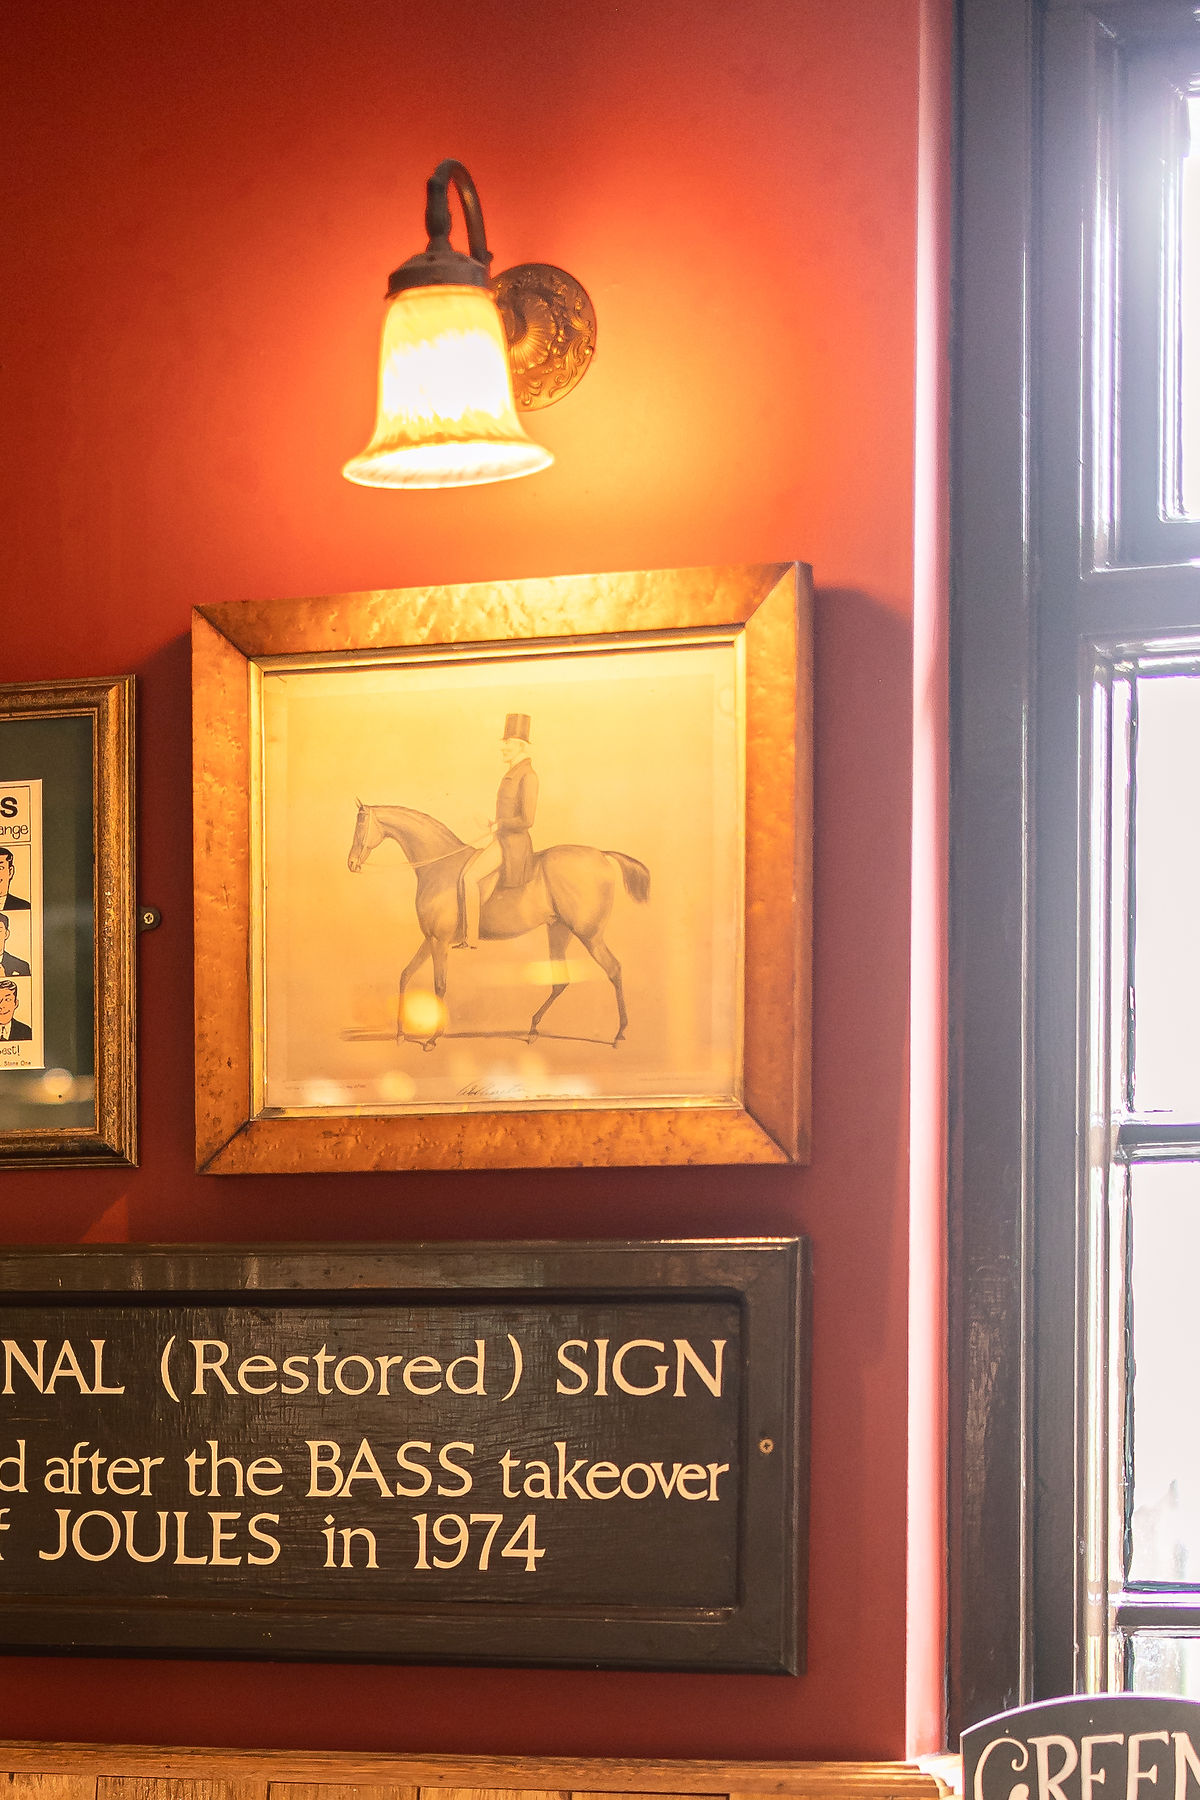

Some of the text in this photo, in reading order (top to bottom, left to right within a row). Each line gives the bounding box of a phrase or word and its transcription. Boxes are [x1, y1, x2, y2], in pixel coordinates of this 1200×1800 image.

[160, 1333, 524, 1403] (Restored)
[556, 1338, 729, 1398] SIGN
[44, 1441, 166, 1496] after
[184, 1439, 285, 1497] the
[304, 1437, 475, 1498] BASS
[497, 1441, 731, 1502] takeover
[38, 1508, 282, 1566] JOULES
[320, 1513, 381, 1569] in
[411, 1513, 547, 1572] 1974
